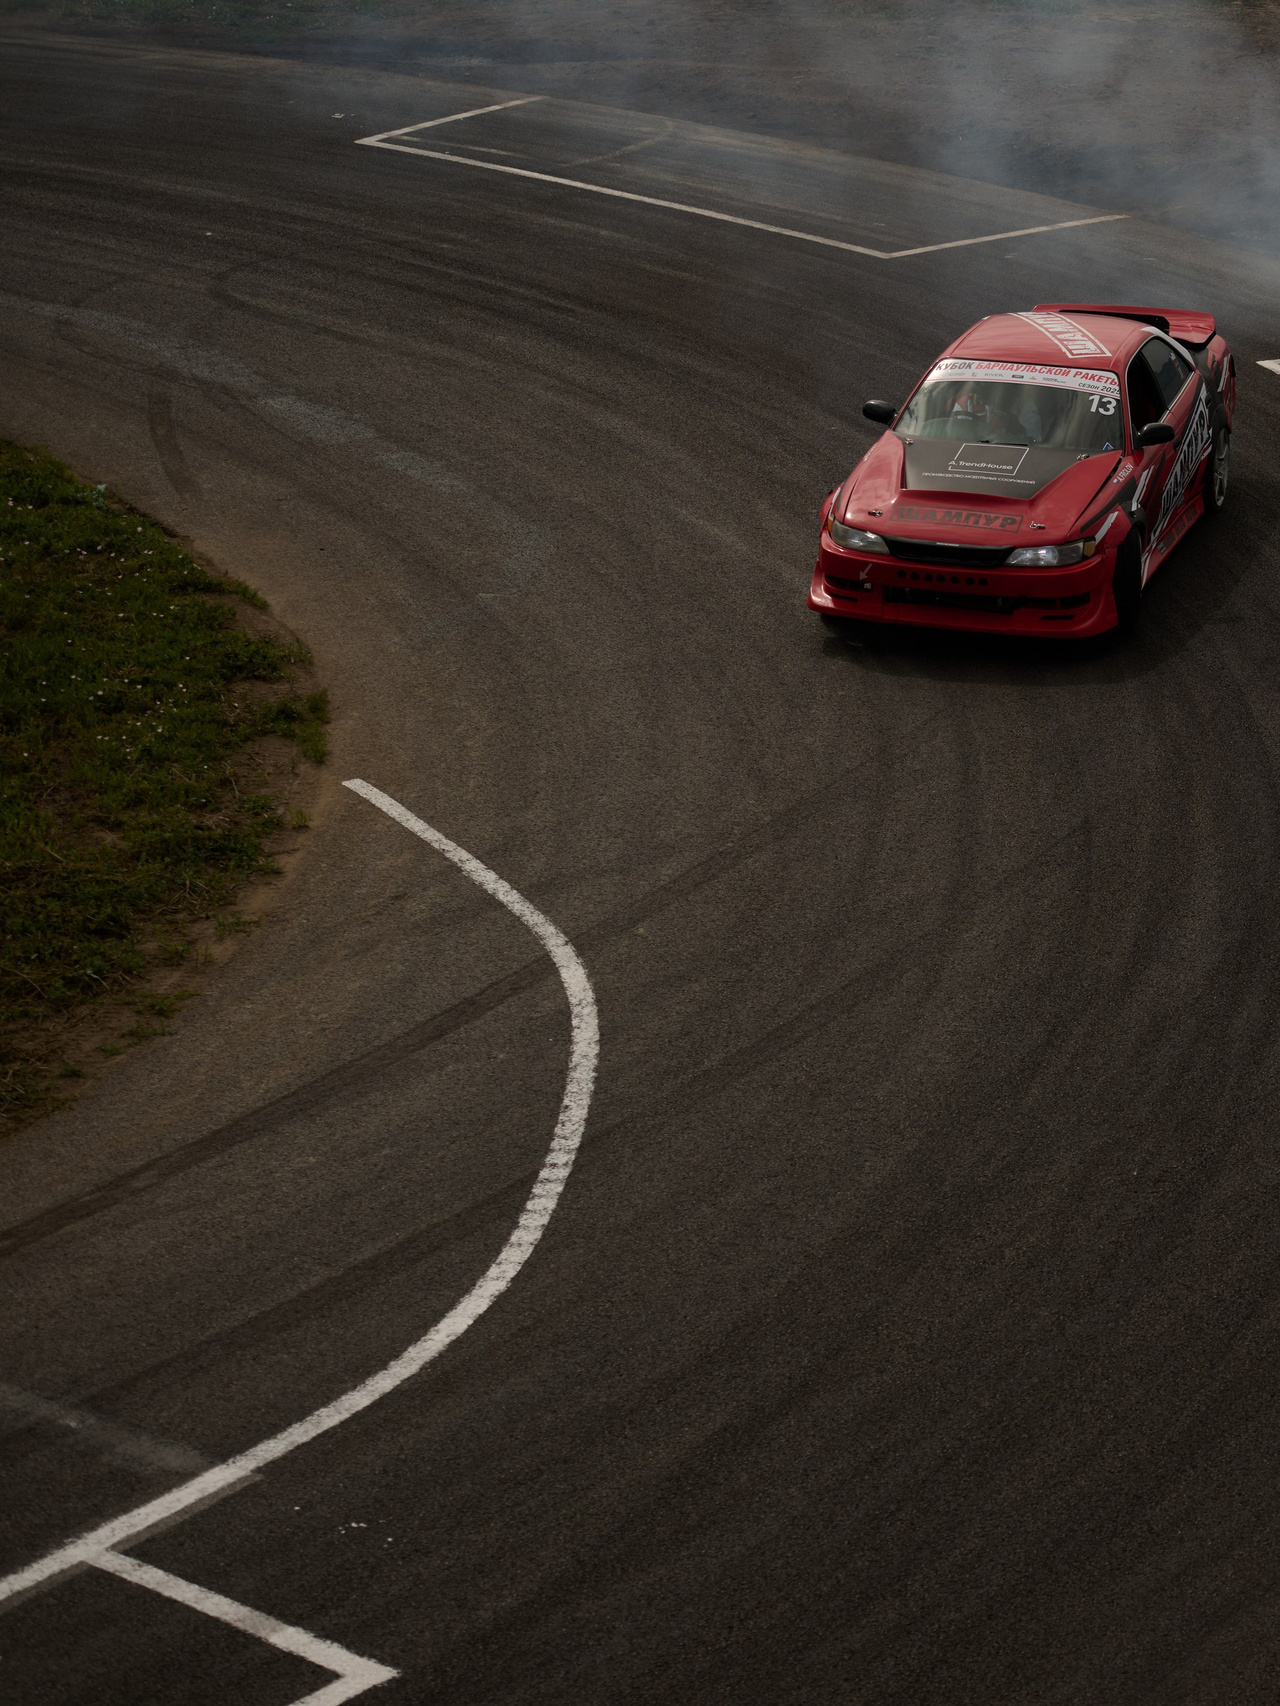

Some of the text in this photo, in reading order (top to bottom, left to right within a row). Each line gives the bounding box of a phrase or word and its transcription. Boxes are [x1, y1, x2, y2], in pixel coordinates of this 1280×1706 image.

[936, 362, 974, 371] КУБОК
[975, 362, 1071, 377] БАРНАУЛЬСКОЙ
[1078, 382, 1099, 390] СЕЗОН
[1088, 394, 1117, 416] 13
[897, 507, 1018, 528] ШАМПУР
